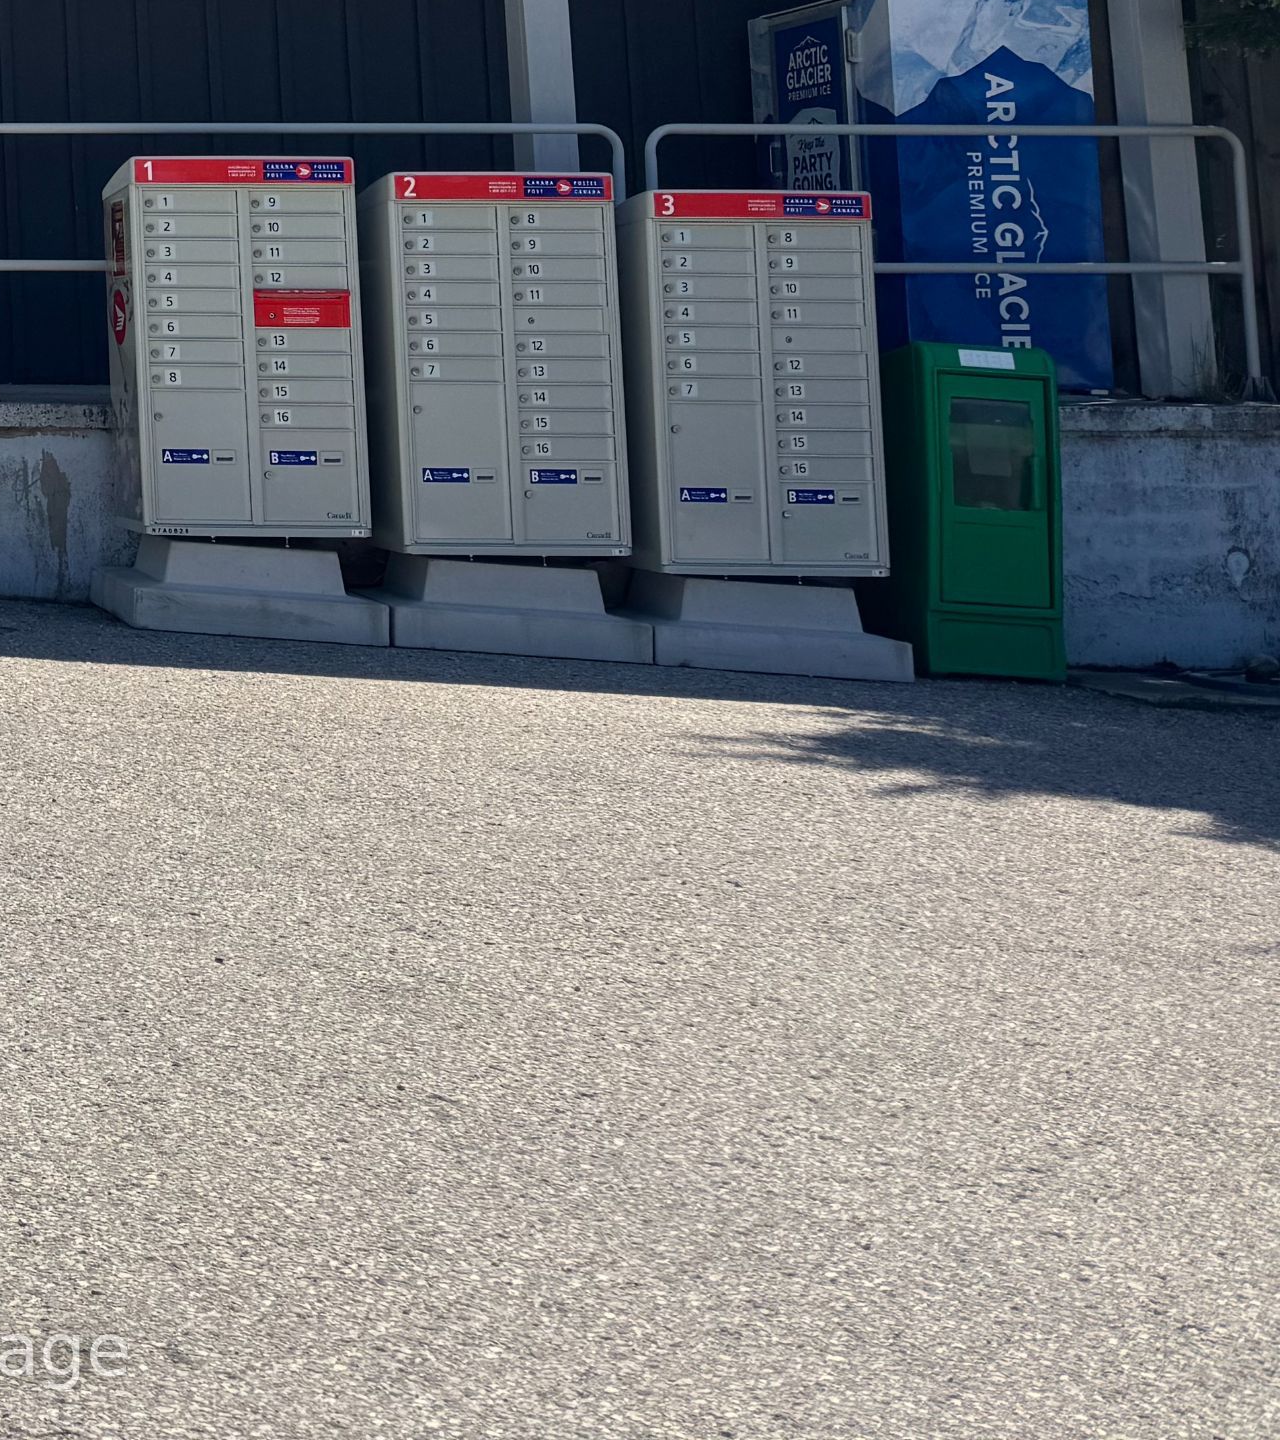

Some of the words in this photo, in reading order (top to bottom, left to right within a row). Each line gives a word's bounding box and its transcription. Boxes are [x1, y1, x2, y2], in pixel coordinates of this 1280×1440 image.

[788, 45, 828, 71] ARCTIC
[786, 63, 831, 90] GLACIER
[788, 86, 818, 102] PREMIUM
[819, 84, 831, 95] ICE
[984, 72, 1022, 210] ARCTIC
[793, 151, 833, 174] PARTY
[143, 161, 153, 181] 1
[403, 177, 417, 197] 2
[268, 197, 276, 208] 9
[661, 195, 675, 215] 3
[966, 151, 988, 254] PREMIUM
[527, 213, 535, 224] 8
[163, 221, 171, 232] 2
[268, 222, 280, 233] 10
[784, 232, 793, 243] 8
[422, 238, 430, 249] 2
[528, 239, 536, 250] 9
[164, 246, 172, 257] 3
[269, 247, 280, 257] 11
[680, 256, 687, 268] 2
[785, 257, 794, 268] 9
[423, 263, 431, 274] 3
[528, 264, 540, 275] 10
[164, 272, 172, 282] 4
[270, 272, 281, 283] 12
[681, 281, 689, 293] 3
[785, 283, 797, 294] 10
[974, 273, 991, 299] CE
[994, 221, 1032, 349] GLACIE
[423, 289, 431, 299] 4
[529, 289, 540, 300] 11
[166, 296, 173, 307] 5
[681, 307, 689, 317] 4
[787, 308, 797, 319] 11
[425, 313, 433, 325] 5
[167, 321, 175, 332] 6
[273, 335, 285, 346] 13
[683, 332, 691, 344] 5
[426, 339, 434, 350] 6
[531, 340, 544, 351] 12
[168, 346, 176, 357] 7
[274, 360, 286, 371] 14
[684, 358, 692, 369] 6
[789, 359, 801, 370] 12
[427, 364, 435, 375] 7
[533, 365, 545, 377] 13
[169, 371, 177, 383] 8
[275, 386, 288, 397] 15
[685, 384, 693, 395] 7
[789, 385, 802, 396] 13
[534, 391, 546, 402] 14
[276, 411, 289, 422] 16
[791, 411, 804, 422] 14
[535, 417, 548, 428] 15
[793, 436, 805, 448] 15
[536, 442, 549, 454] 16
[163, 450, 173, 461] A
[271, 452, 279, 463] B
[794, 462, 807, 474] 16
[423, 469, 433, 480] A
[531, 471, 539, 482] B
[681, 489, 691, 500] A
[788, 491, 797, 502] B
